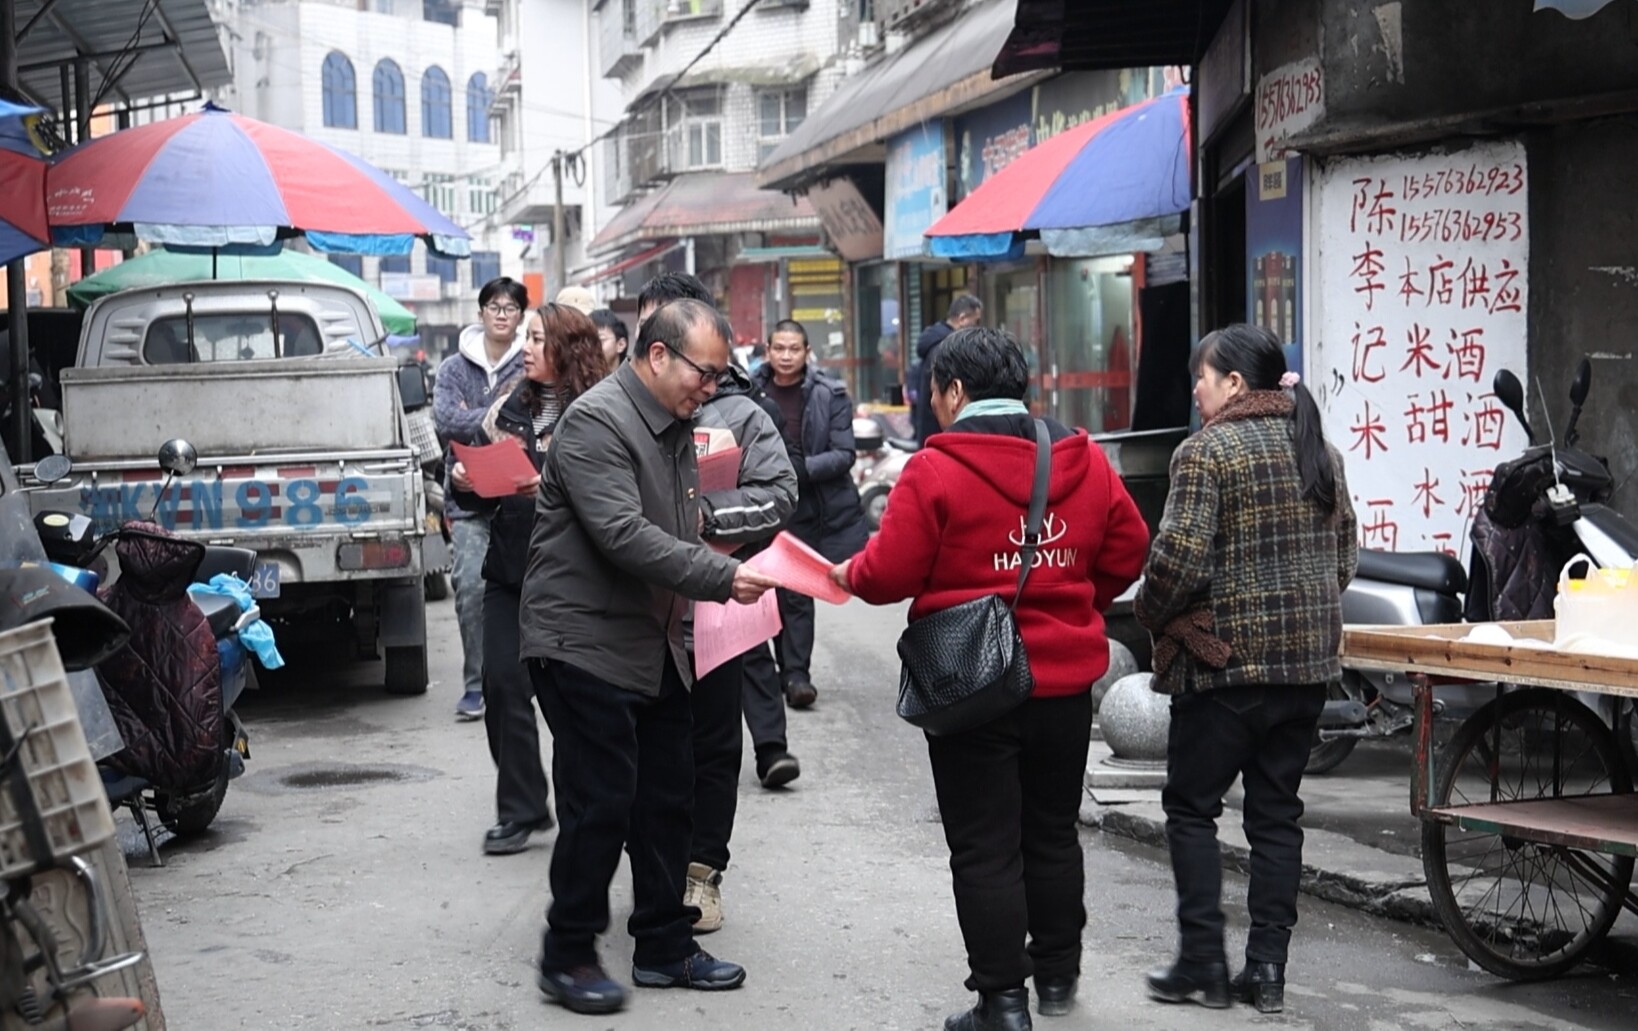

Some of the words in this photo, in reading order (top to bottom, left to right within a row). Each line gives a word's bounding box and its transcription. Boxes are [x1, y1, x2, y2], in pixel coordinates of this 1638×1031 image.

[1403, 164, 1523, 201] 15576362923
[1400, 209, 1522, 242] 15576362953
[1398, 254, 1521, 315] 本店供应
[1399, 322, 1486, 384] 米酒
[1404, 388, 1504, 451] 甜酒
